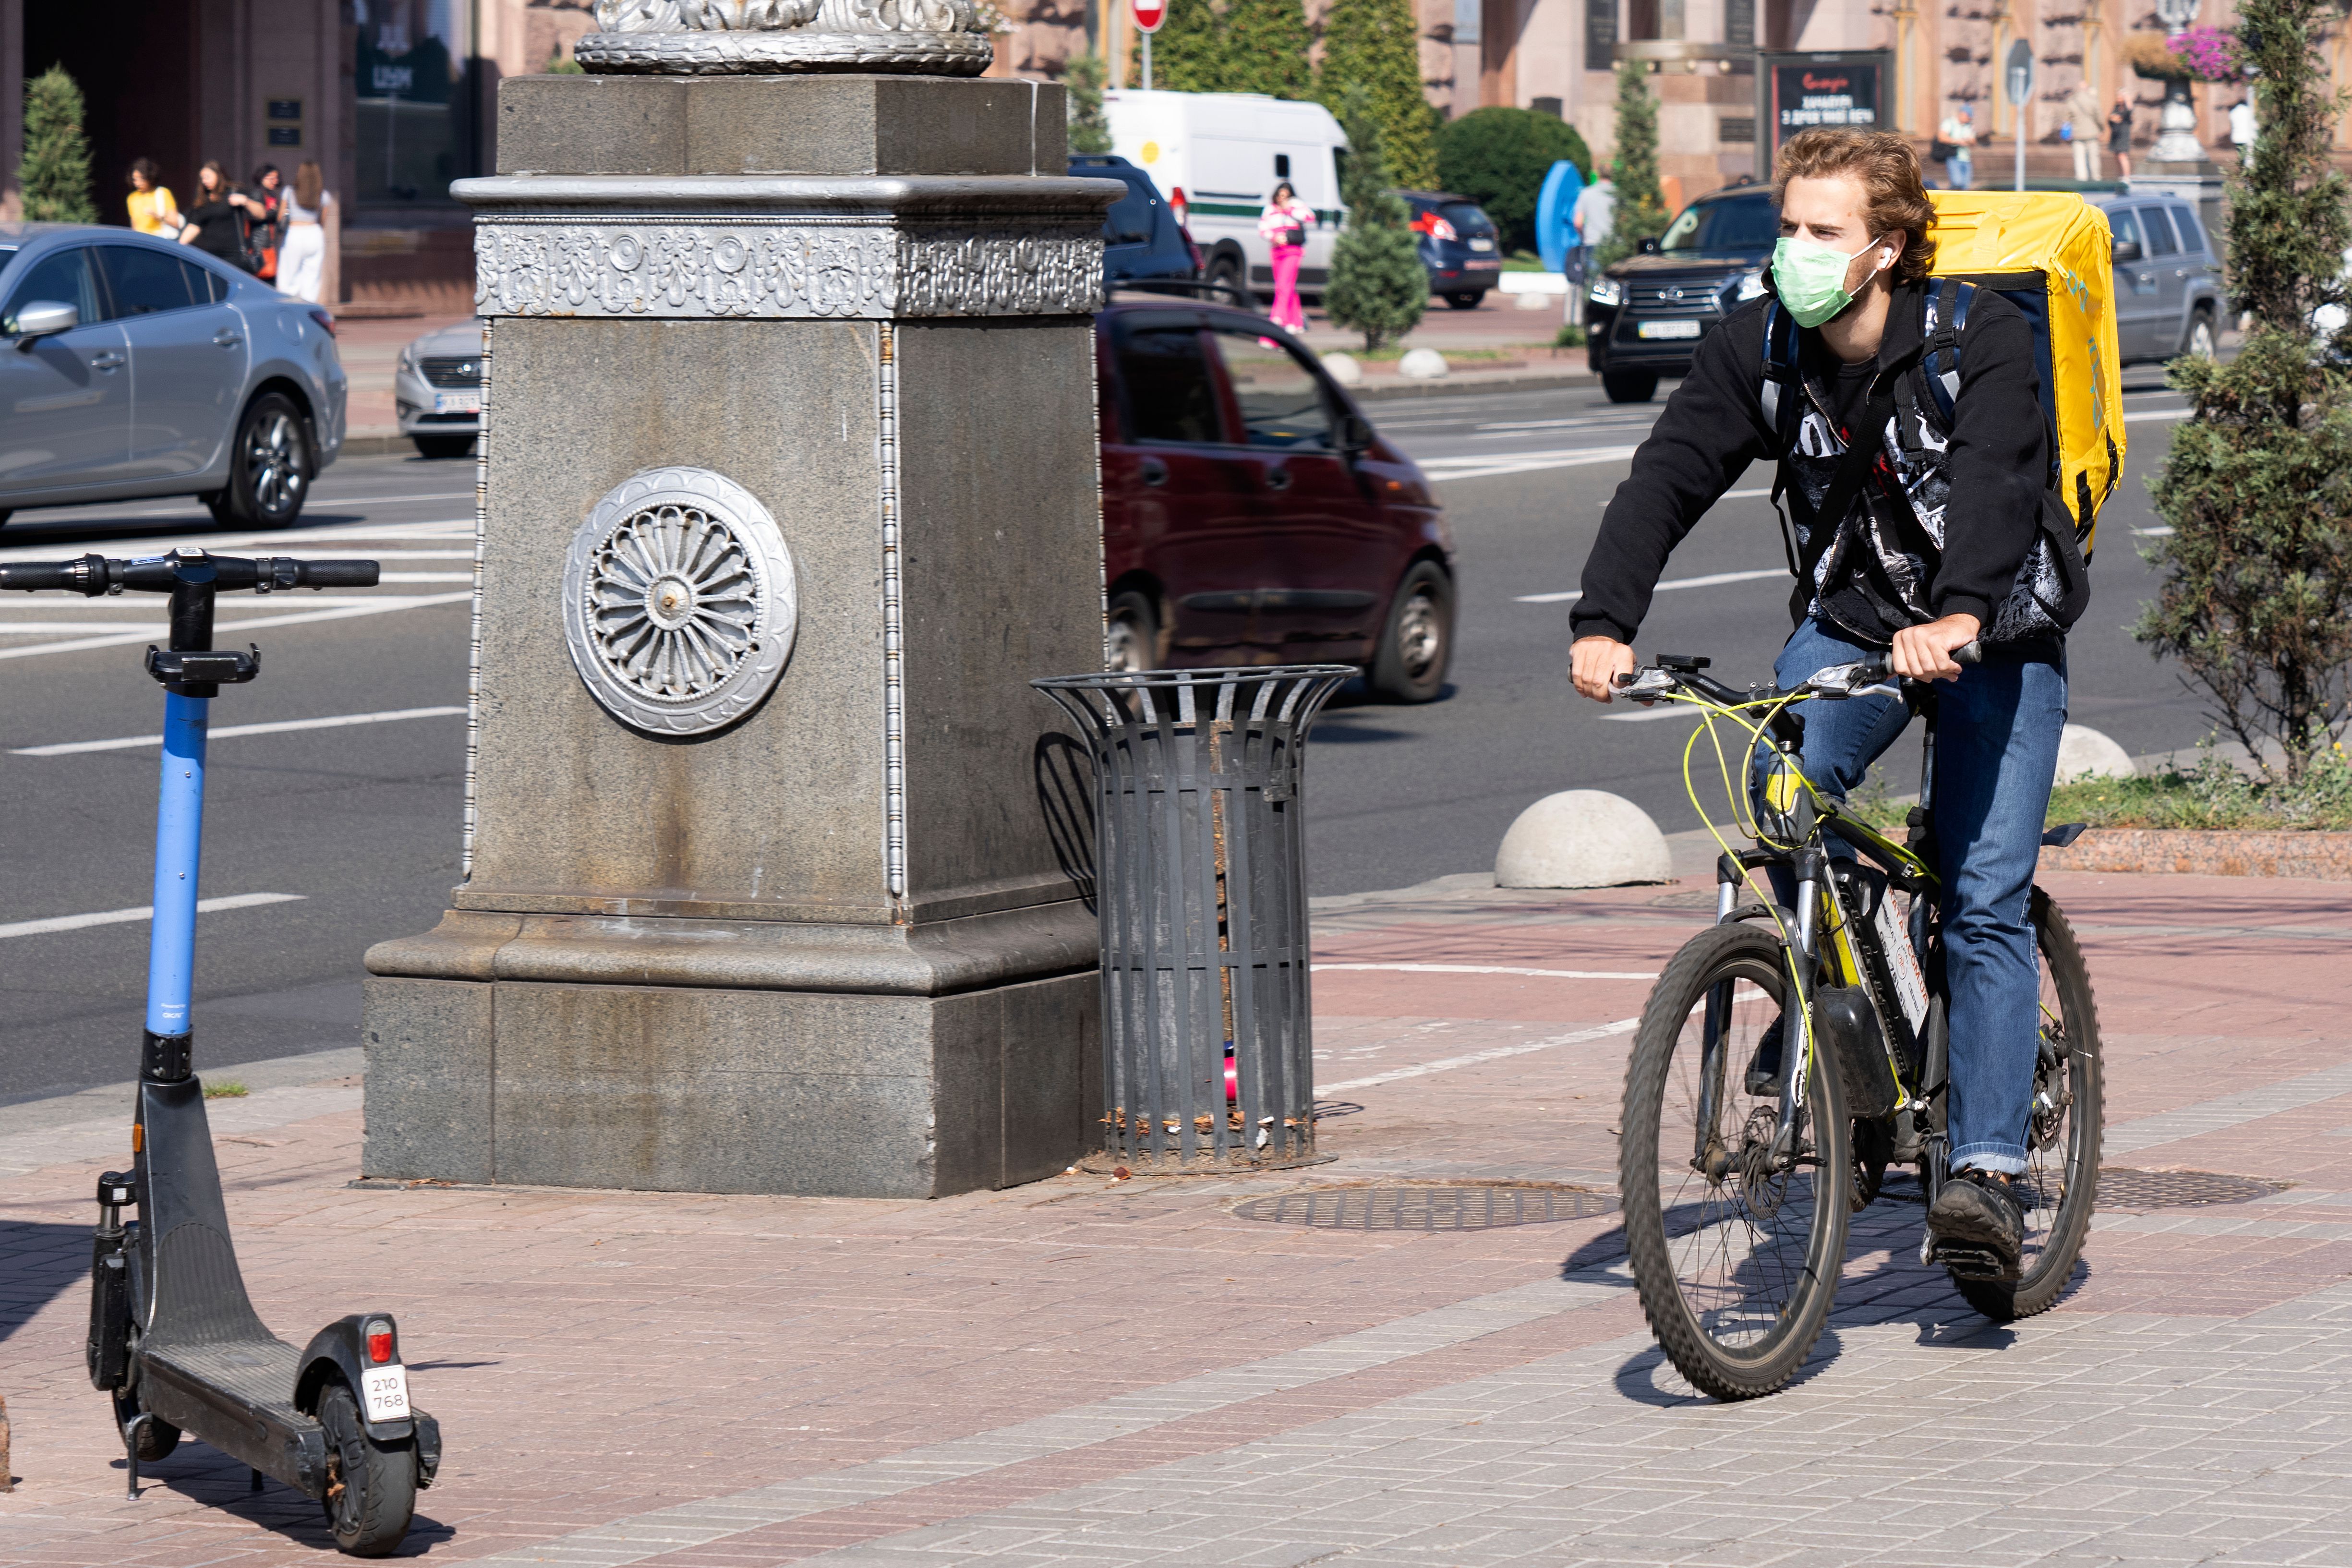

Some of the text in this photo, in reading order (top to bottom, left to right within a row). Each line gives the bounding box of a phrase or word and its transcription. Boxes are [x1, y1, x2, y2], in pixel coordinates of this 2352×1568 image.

[1698, 678, 1721, 692] ZOOM
[372, 1377, 398, 1391] 210
[374, 1394, 403, 1409] 768
